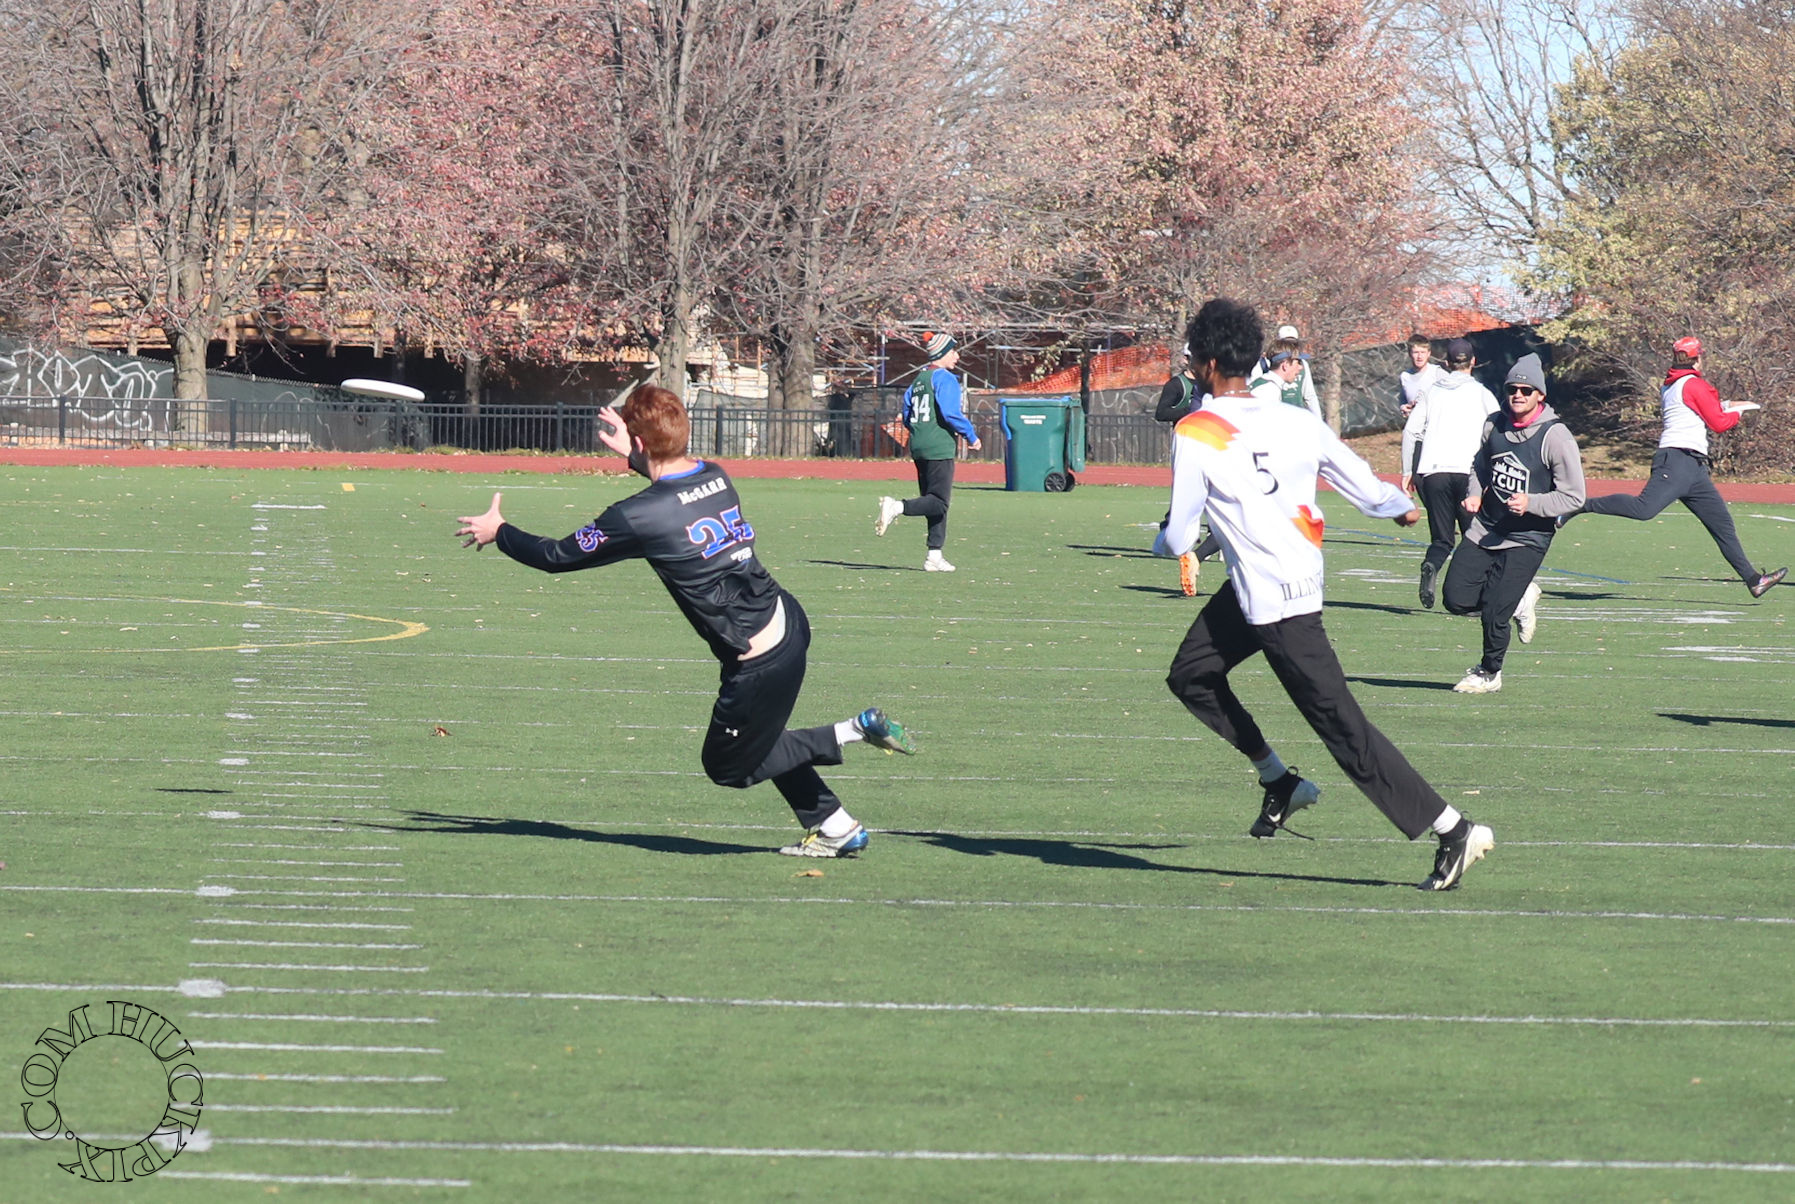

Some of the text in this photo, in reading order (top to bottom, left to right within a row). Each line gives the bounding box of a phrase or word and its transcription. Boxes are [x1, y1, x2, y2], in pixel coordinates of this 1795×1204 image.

[677, 477, 727, 505] McGARR
[1253, 452, 1279, 495] 5
[685, 505, 754, 559] 25
